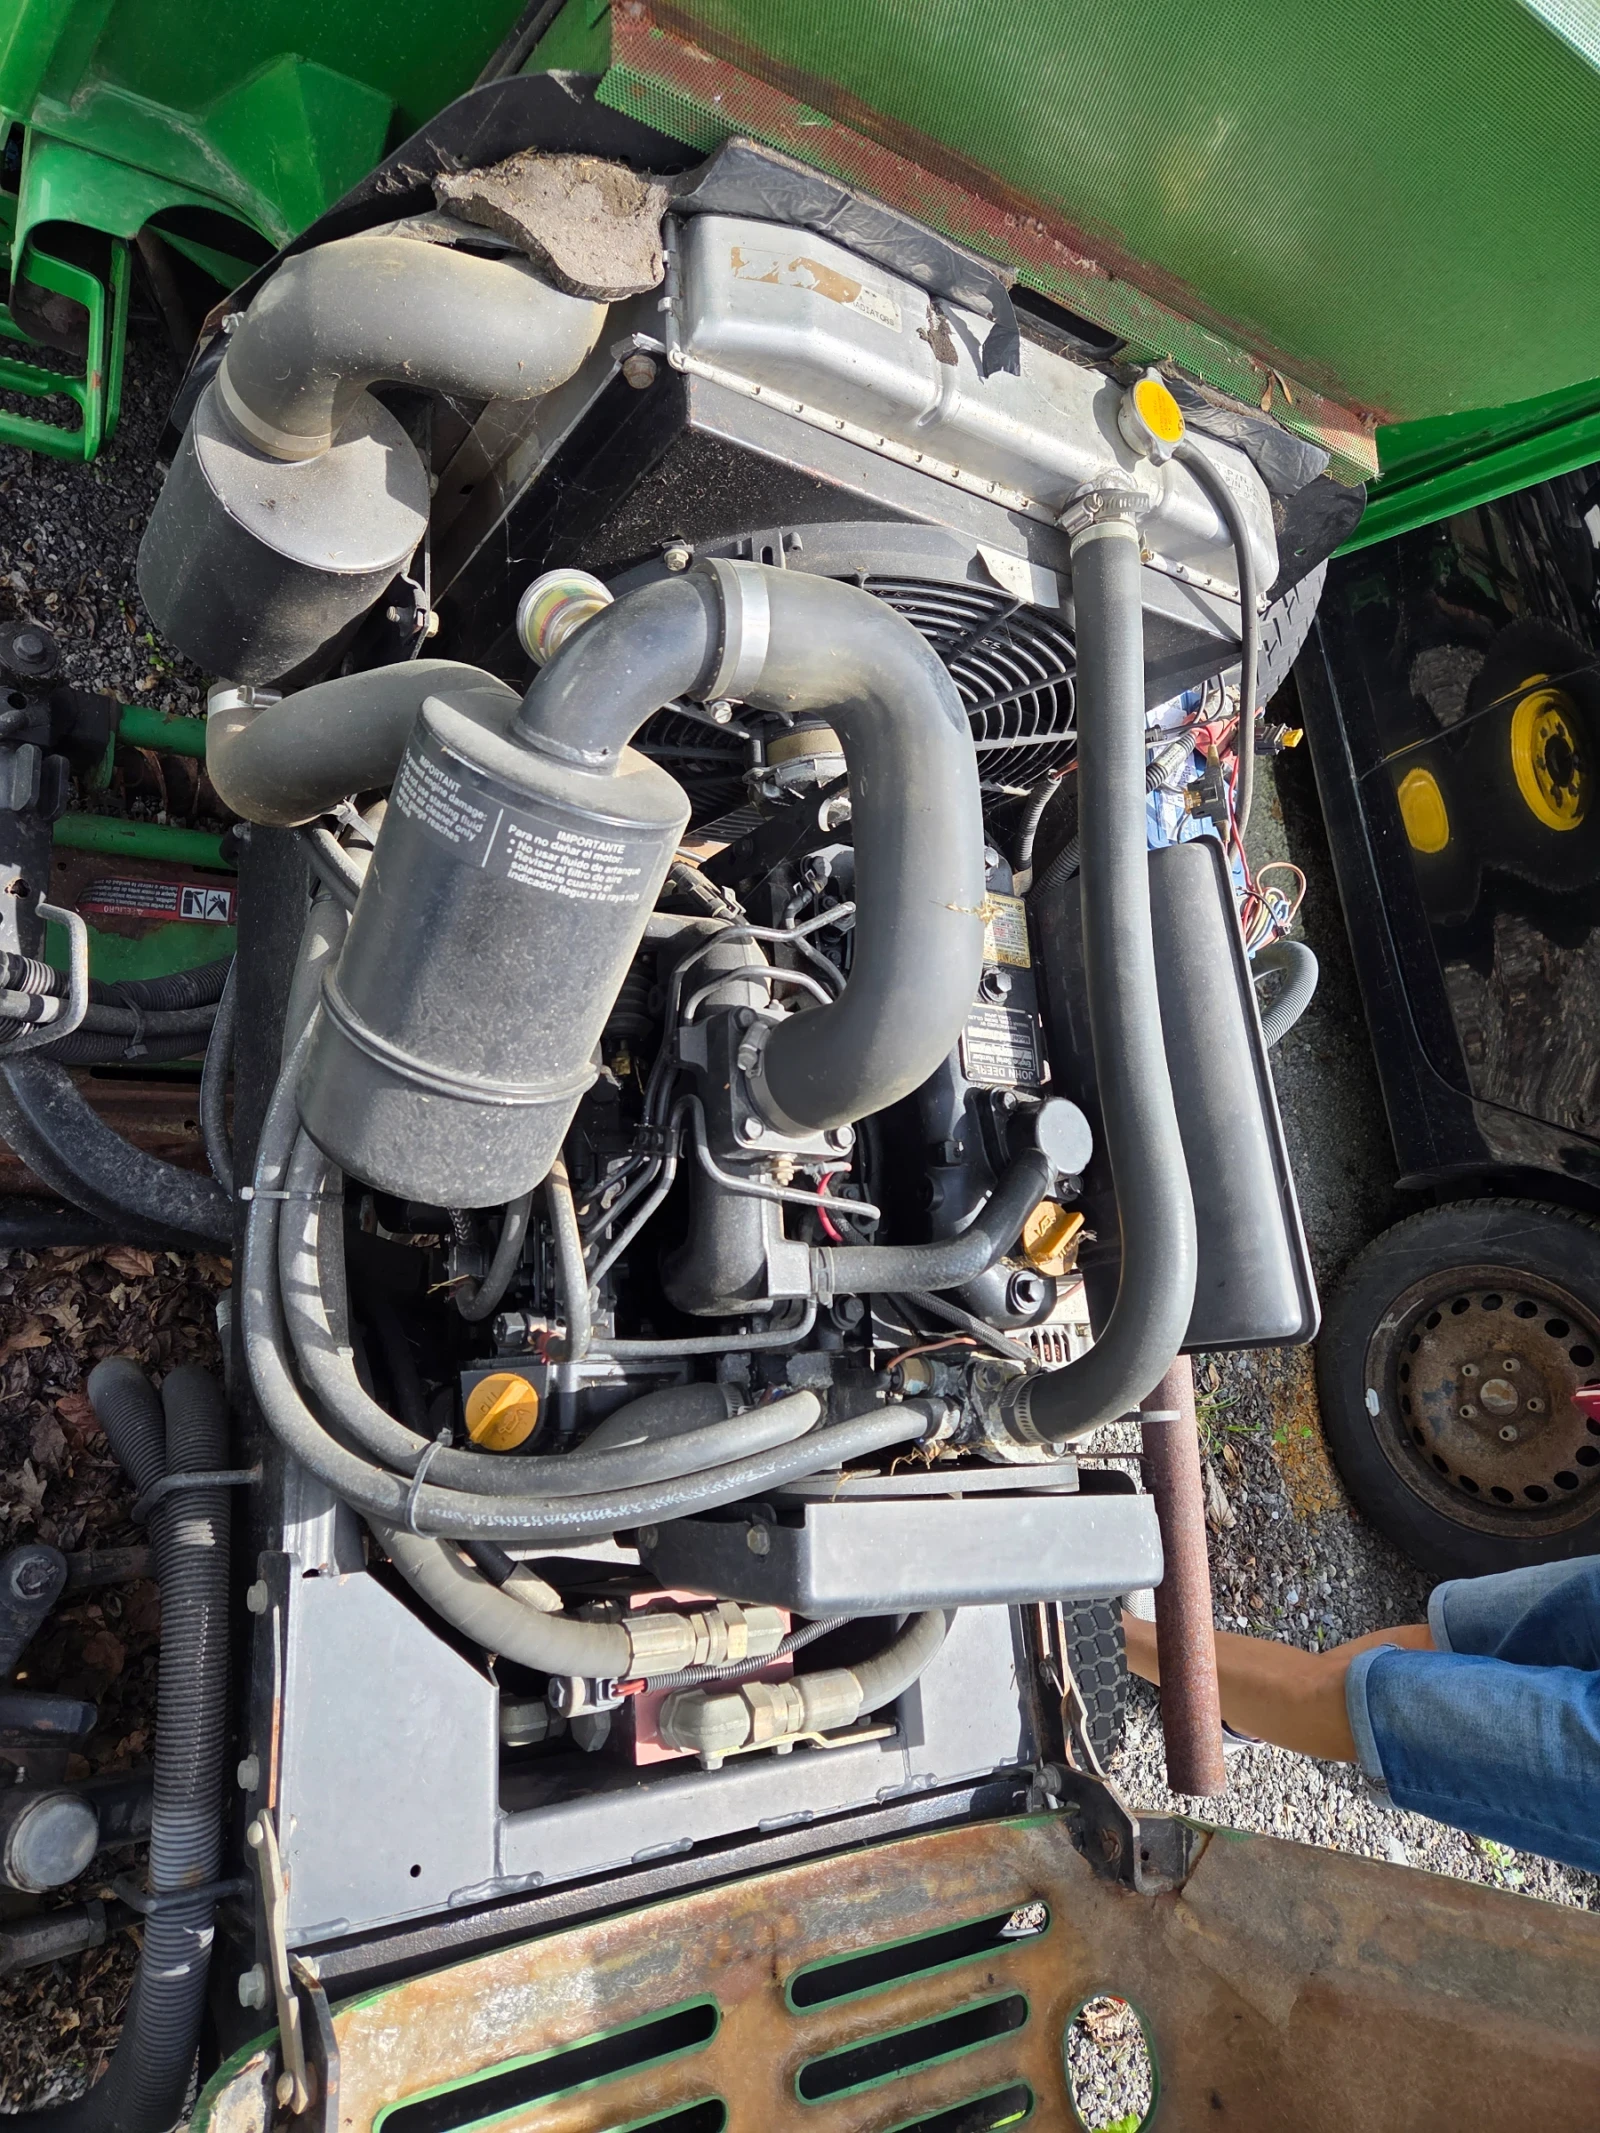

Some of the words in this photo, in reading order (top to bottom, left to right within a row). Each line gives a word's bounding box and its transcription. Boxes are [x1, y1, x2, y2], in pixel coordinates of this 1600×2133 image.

[420, 755, 461, 793] IMPORTANT
[424, 775, 448, 798] engine
[448, 793, 488, 822] damage:
[429, 794, 460, 822] starting
[460, 814, 484, 833] fluid
[425, 803, 454, 828] cleaner
[454, 823, 477, 842] only
[426, 816, 460, 842] reaches
[508, 824, 533, 842] Para
[533, 835, 549, 847] no
[550, 841, 582, 857] dañar
[581, 849, 593, 860] el
[592, 852, 624, 864] motor:
[517, 840, 533, 853] No
[534, 847, 560, 862] usar
[560, 854, 590, 870] fluido
[590, 862, 604, 872] de
[556, 830, 626, 854] IMPORTANTE
[511, 861, 565, 884] solamente
[565, 878, 603, 892] cuando
[602, 883, 613, 893] el
[514, 849, 555, 871] Revisar
[555, 865, 568, 875] el
[567, 867, 591, 881] filtro
[591, 872, 605, 883] de
[605, 874, 623, 884] aire
[506, 869, 558, 892] indicador
[557, 884, 589, 899] llegue
[597, 891, 607, 901] la
[972, 1054, 995, 1062] Number
[973, 1064, 1005, 1076] DEERE
[996, 1056, 1012, 1065] Serial
[1008, 1069, 1033, 1080] JOHN
